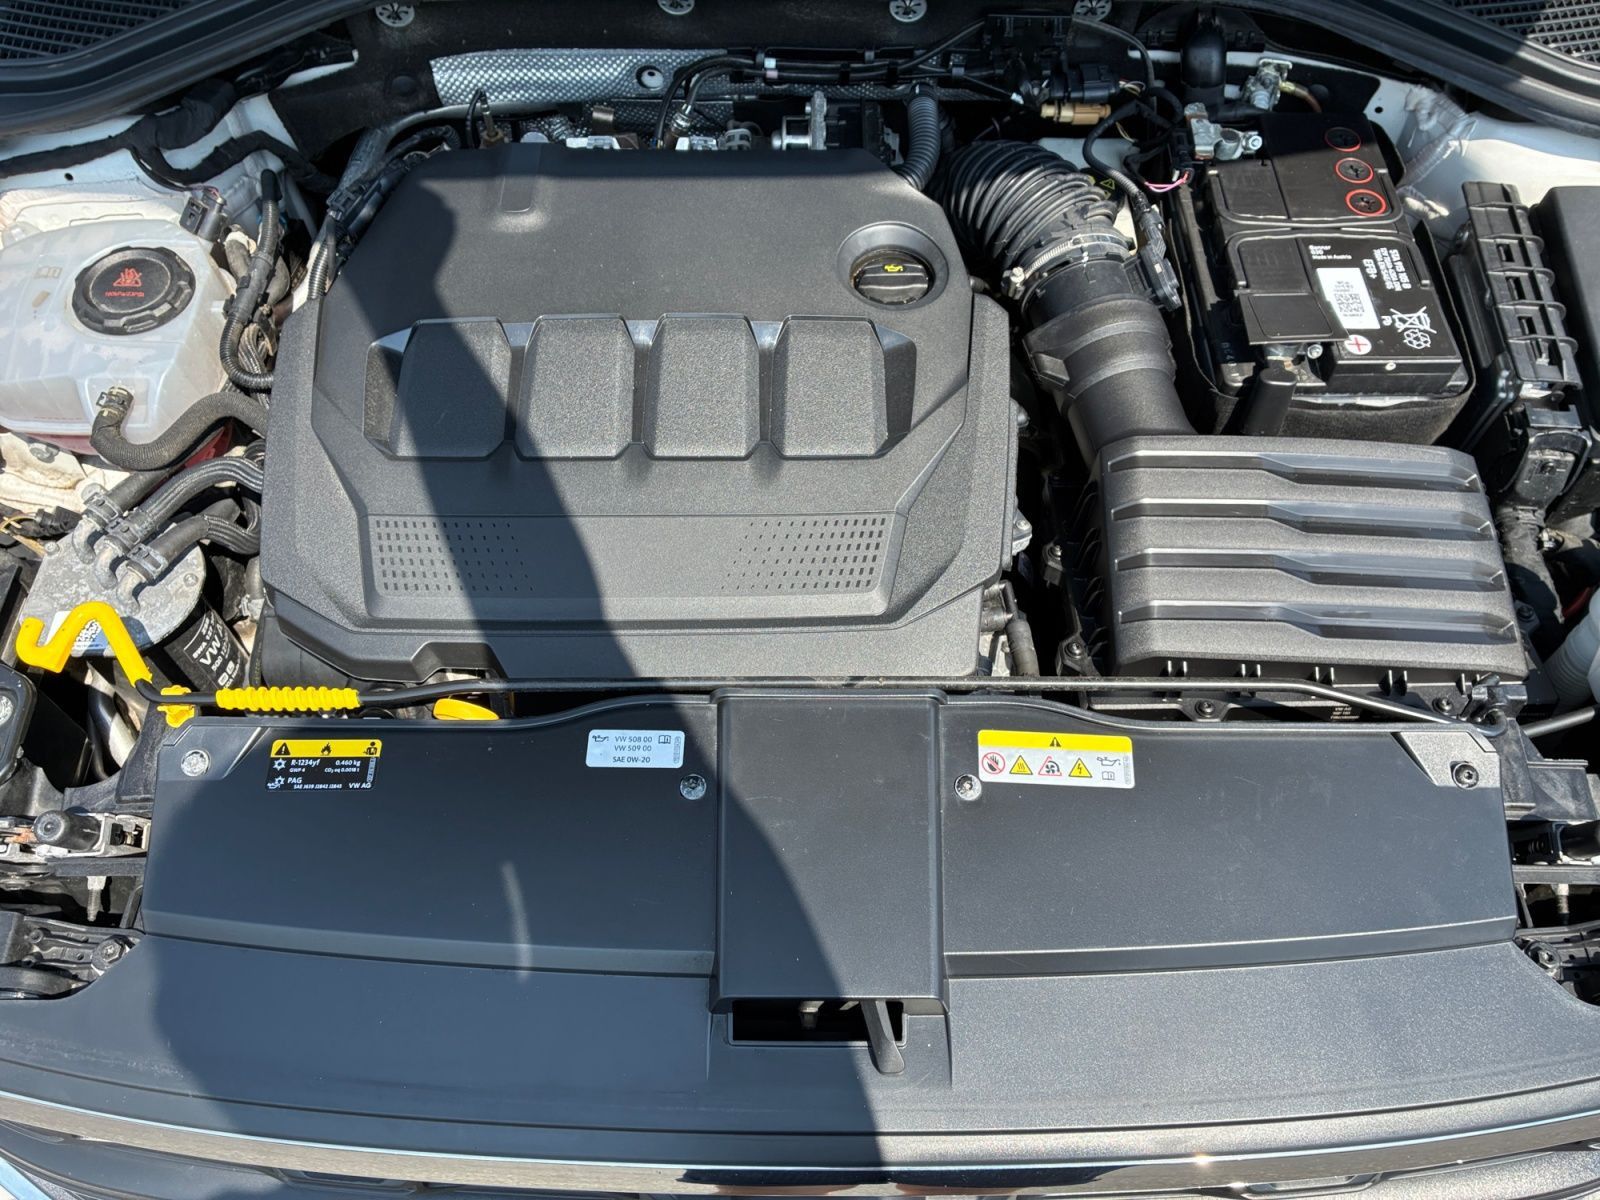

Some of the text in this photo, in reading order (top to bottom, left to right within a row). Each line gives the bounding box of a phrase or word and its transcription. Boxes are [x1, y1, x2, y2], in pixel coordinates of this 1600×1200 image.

[1362, 259, 1377, 278] EFB+
[200, 635, 220, 665] VW
[291, 759, 320, 767] R-1234yf
